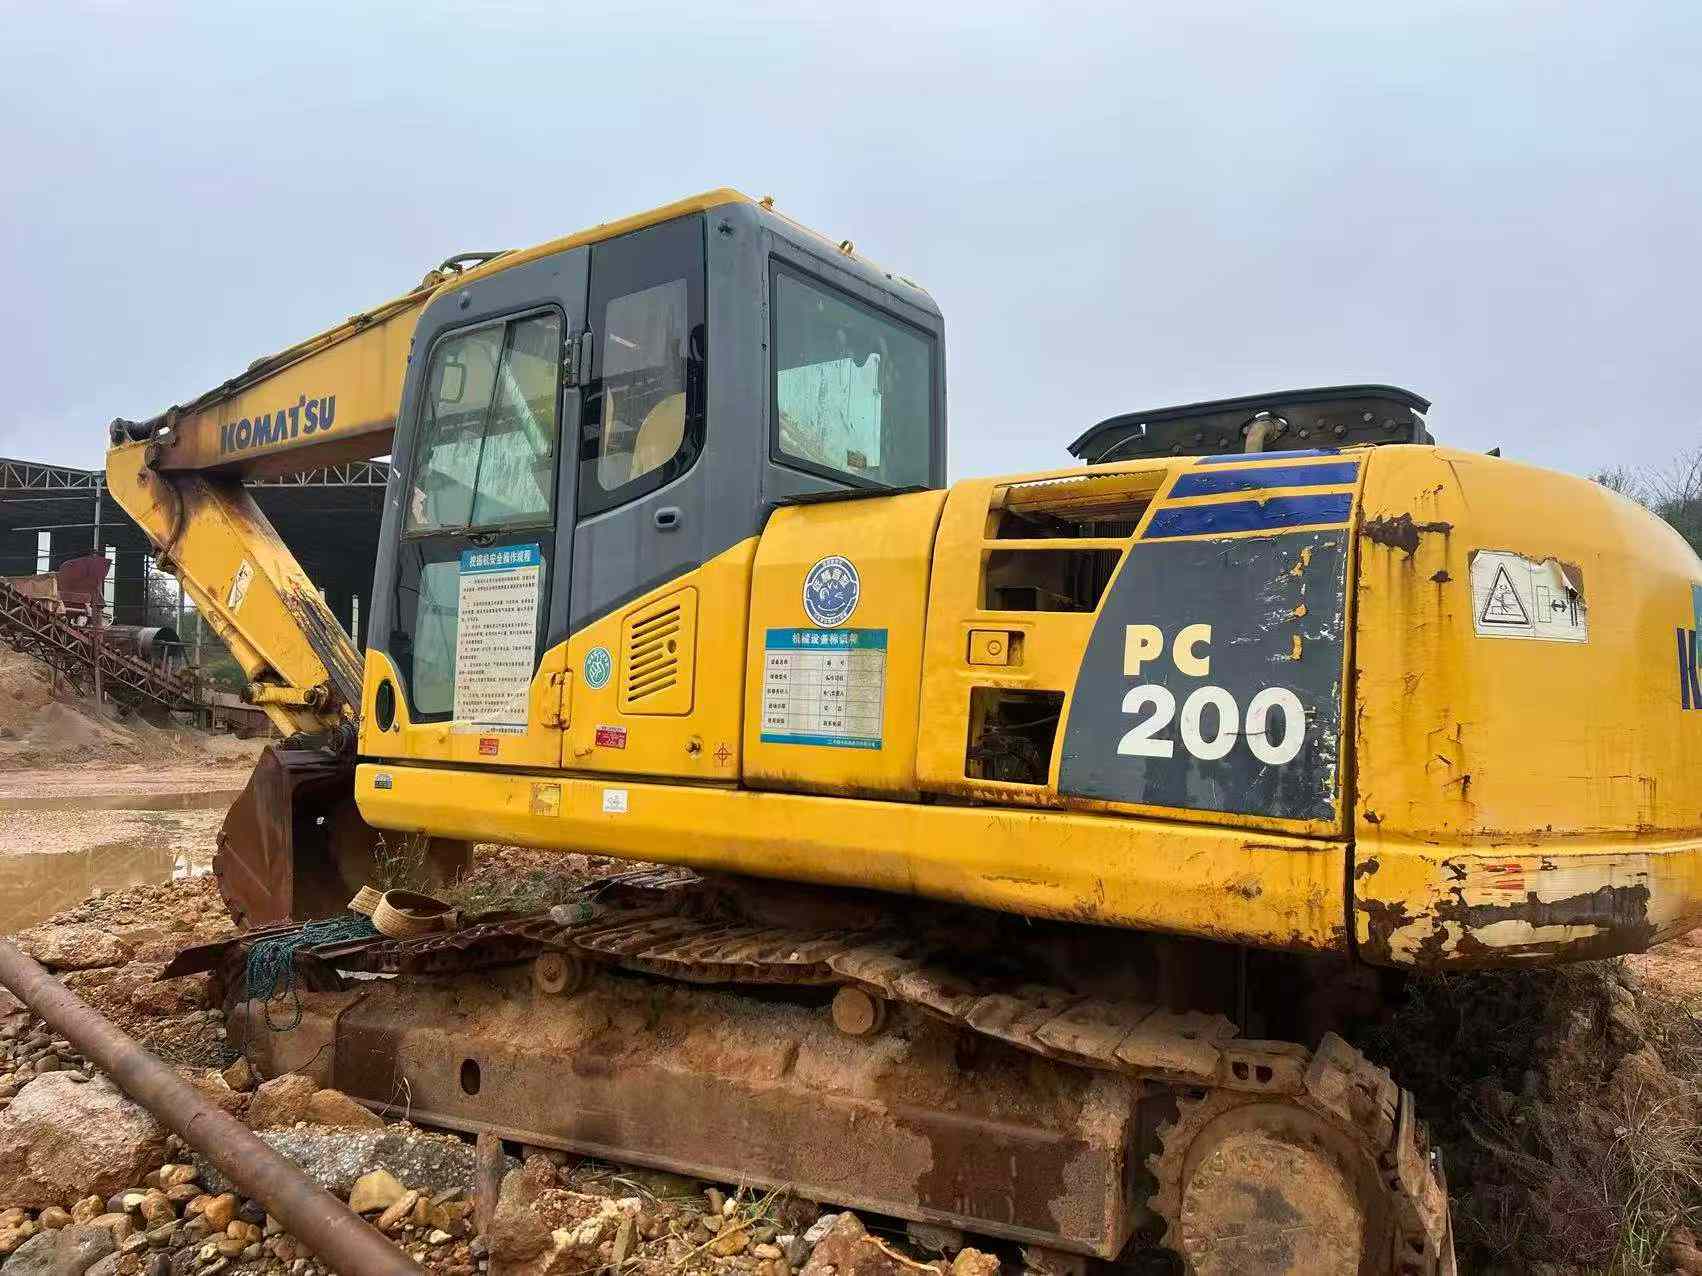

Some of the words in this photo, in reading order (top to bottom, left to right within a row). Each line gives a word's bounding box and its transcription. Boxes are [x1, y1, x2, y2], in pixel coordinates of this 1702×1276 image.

[221, 394, 336, 451] KOMATSU
[1124, 624, 1212, 677] PC
[1117, 684, 1306, 765] 200
